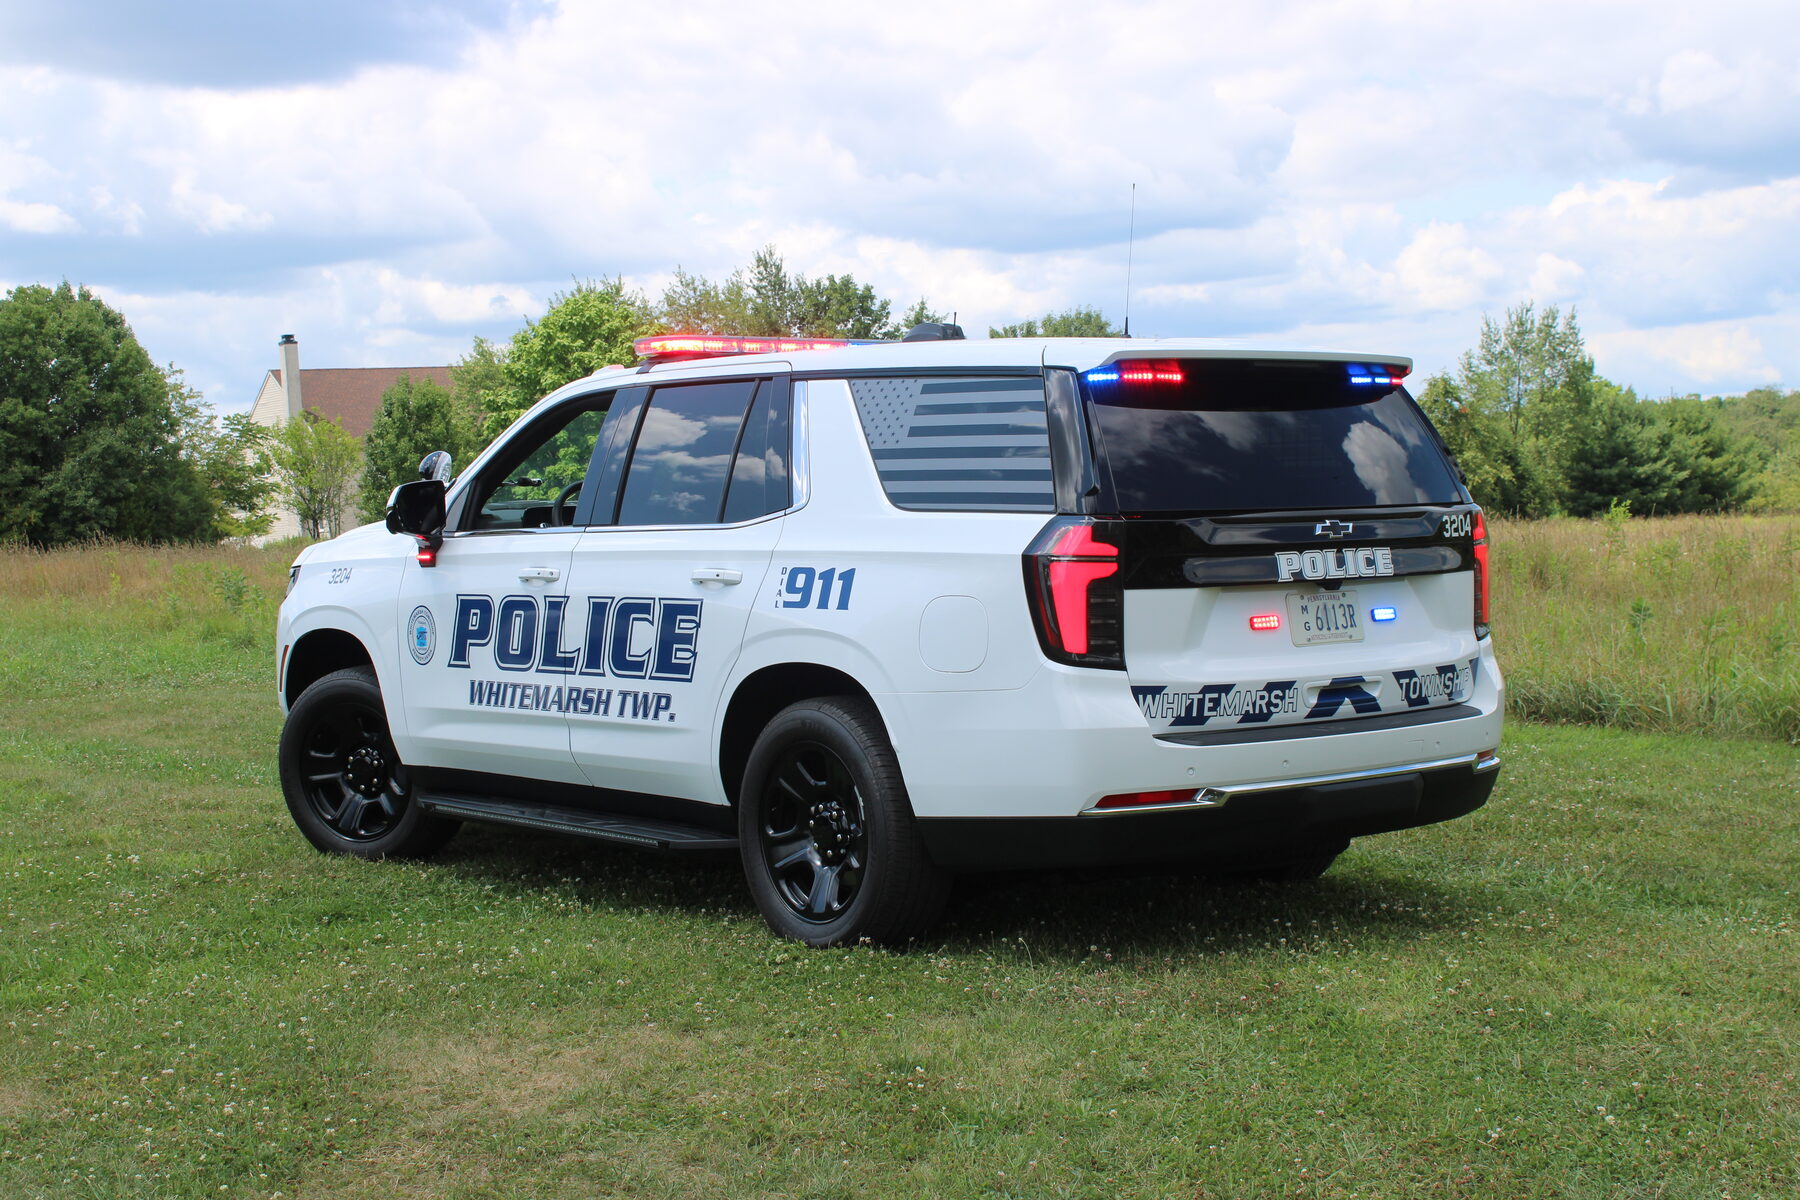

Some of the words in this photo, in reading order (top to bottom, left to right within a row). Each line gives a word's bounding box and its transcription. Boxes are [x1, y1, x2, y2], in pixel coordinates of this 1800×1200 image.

[1442, 514, 1472, 538] 3204
[328, 567, 353, 585] 3204
[1274, 547, 1394, 582] POLICE
[775, 566, 788, 609] DIAL
[783, 566, 856, 611] 911
[1307, 594, 1341, 603] PENNSYLVANIA
[1315, 603, 1357, 631] 6113R
[447, 594, 704, 683] POLICE
[469, 679, 613, 716] WHITEMARSH
[617, 690, 676, 723] TWP.
[1138, 688, 1299, 719] WHITEMARSH
[1399, 666, 1470, 702] TOWNSHIP
